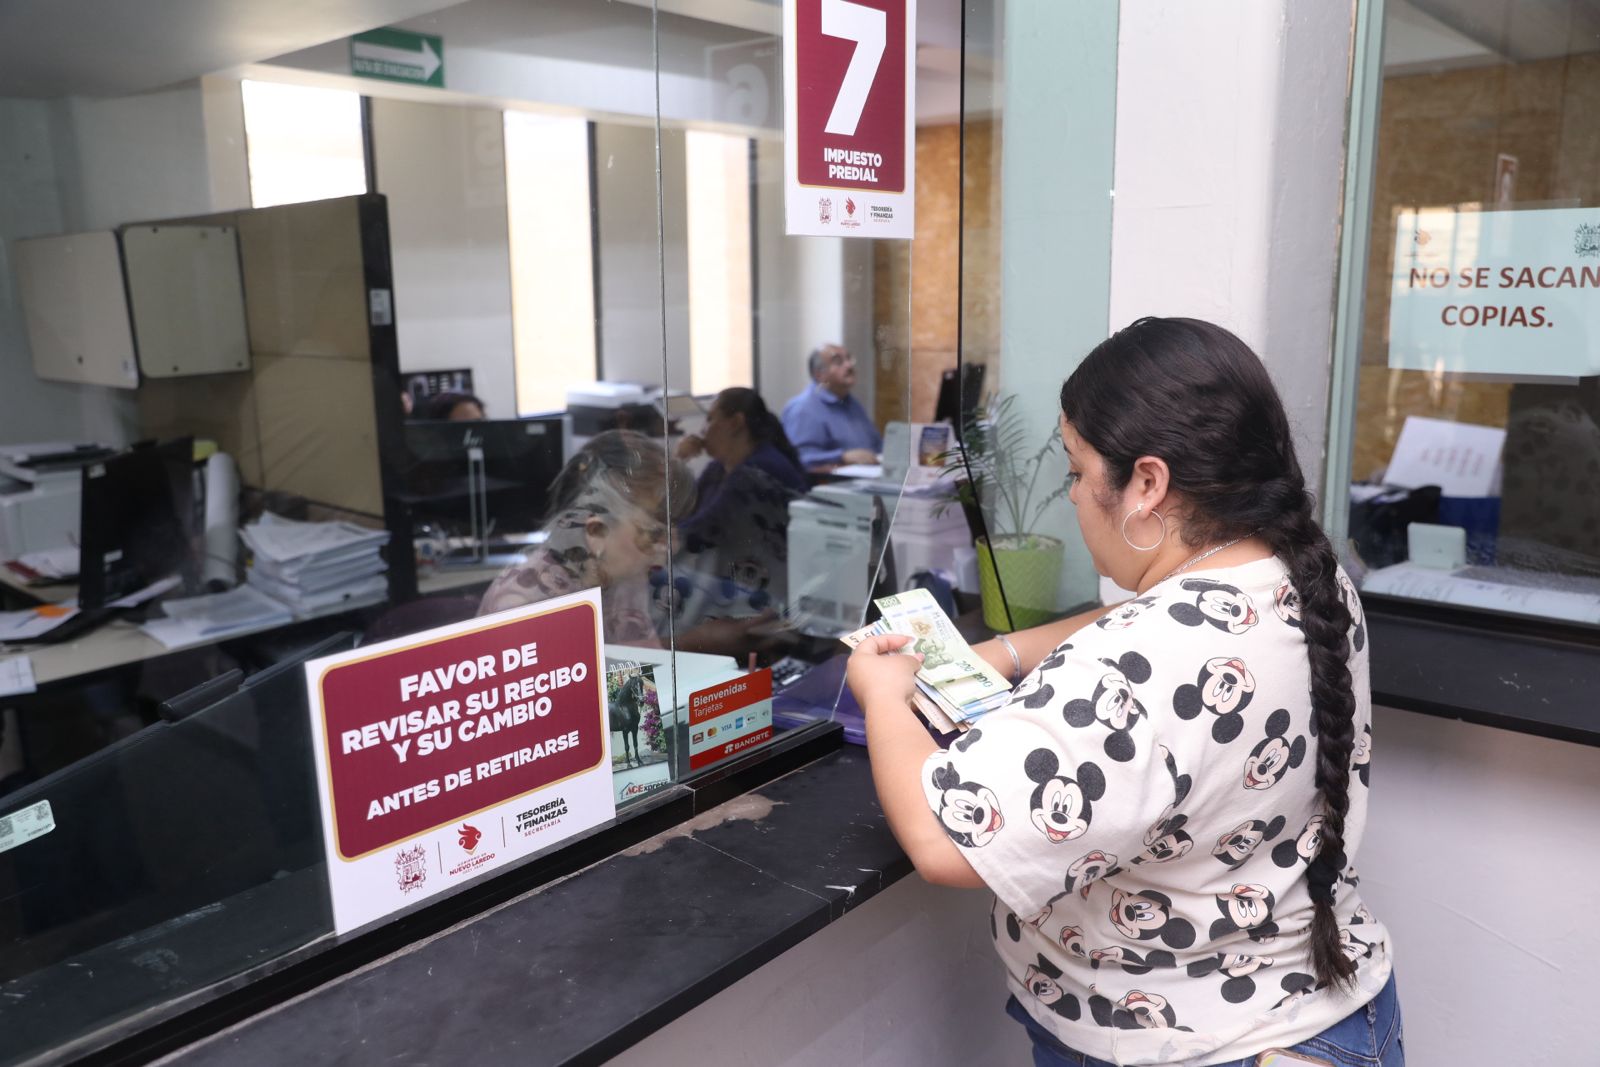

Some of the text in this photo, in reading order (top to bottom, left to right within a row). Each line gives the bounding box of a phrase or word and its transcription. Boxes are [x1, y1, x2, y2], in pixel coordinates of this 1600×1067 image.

[821, 0, 887, 136] 7
[824, 147, 882, 168] IMPUESTO
[828, 164, 879, 183] PREDIAL
[1409, 266, 1600, 289] NO SE SACAN
[1440, 304, 1554, 329] COPIAS.
[400, 641, 539, 702] FAVOR DE
[693, 682, 748, 708] Bienvenidas
[341, 662, 588, 755] REVISAR SU RECIBO
[694, 702, 724, 718] Tarjetas
[391, 696, 553, 764] Y SU CAMBIO
[721, 723, 733, 732] VISA
[734, 731, 770, 750] BANORTE
[366, 730, 580, 821] ANTES DE RETIRARSE
[515, 806, 568, 833] Y FINANZAS
[516, 797, 566, 822] TESORERÍA
[449, 863, 472, 876] NUEVO
[472, 853, 496, 867] LAREDO
